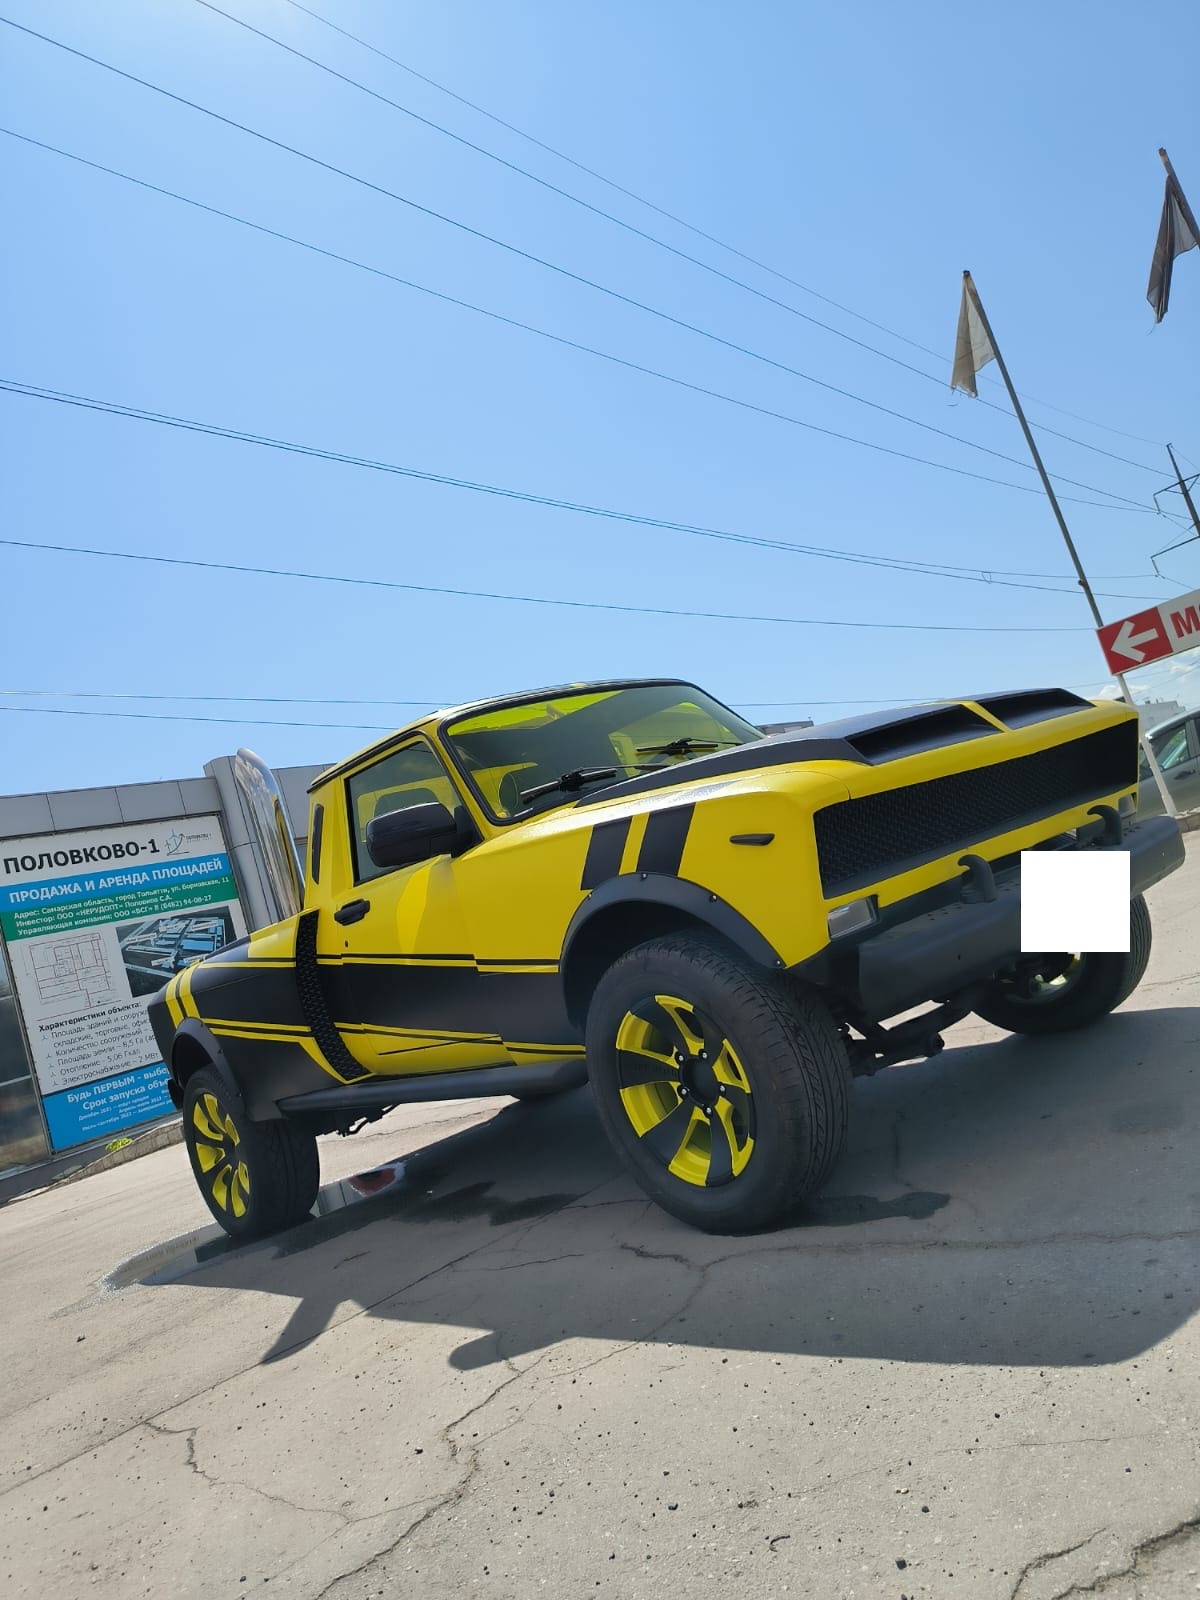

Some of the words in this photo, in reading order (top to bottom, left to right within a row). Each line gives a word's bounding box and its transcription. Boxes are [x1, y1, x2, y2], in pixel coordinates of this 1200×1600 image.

[1169, 604, 1200, 638] М
[3, 838, 160, 875] ПОЛОВКОВО-1
[9, 882, 82, 904] ПРОДАЖА
[84, 879, 96, 891] И
[99, 872, 150, 889] АРЕНДА
[152, 857, 223, 880] ПЛОЩАДЕЙ
[14, 909, 40, 920] Адрес:
[41, 902, 82, 914] Самарская
[83, 897, 114, 908] область,
[115, 893, 136, 903] город
[137, 888, 170, 899] Тольятти,
[16, 916, 55, 928] Инвестор:
[57, 912, 74, 920] ООО
[18, 921, 73, 936] Управляющая
[38, 1011, 106, 1032] Характеристики
[107, 1002, 141, 1016] объекта:
[51, 1026, 85, 1039] Площадь
[88, 1018, 112, 1031] зданий
[55, 1041, 98, 1056] Количество
[100, 1030, 142, 1044] сооружений
[57, 1051, 92, 1066] Площадь
[93, 1046, 115, 1057] земли
[60, 1061, 100, 1076] Отопление
[62, 1061, 130, 1085] Электроснабжение
[67, 1091, 92, 1103] Будь
[93, 1075, 135, 1095] ПЕРВЫМ
[82, 1098, 107, 1111] Срок
[109, 1085, 146, 1103] запуска
